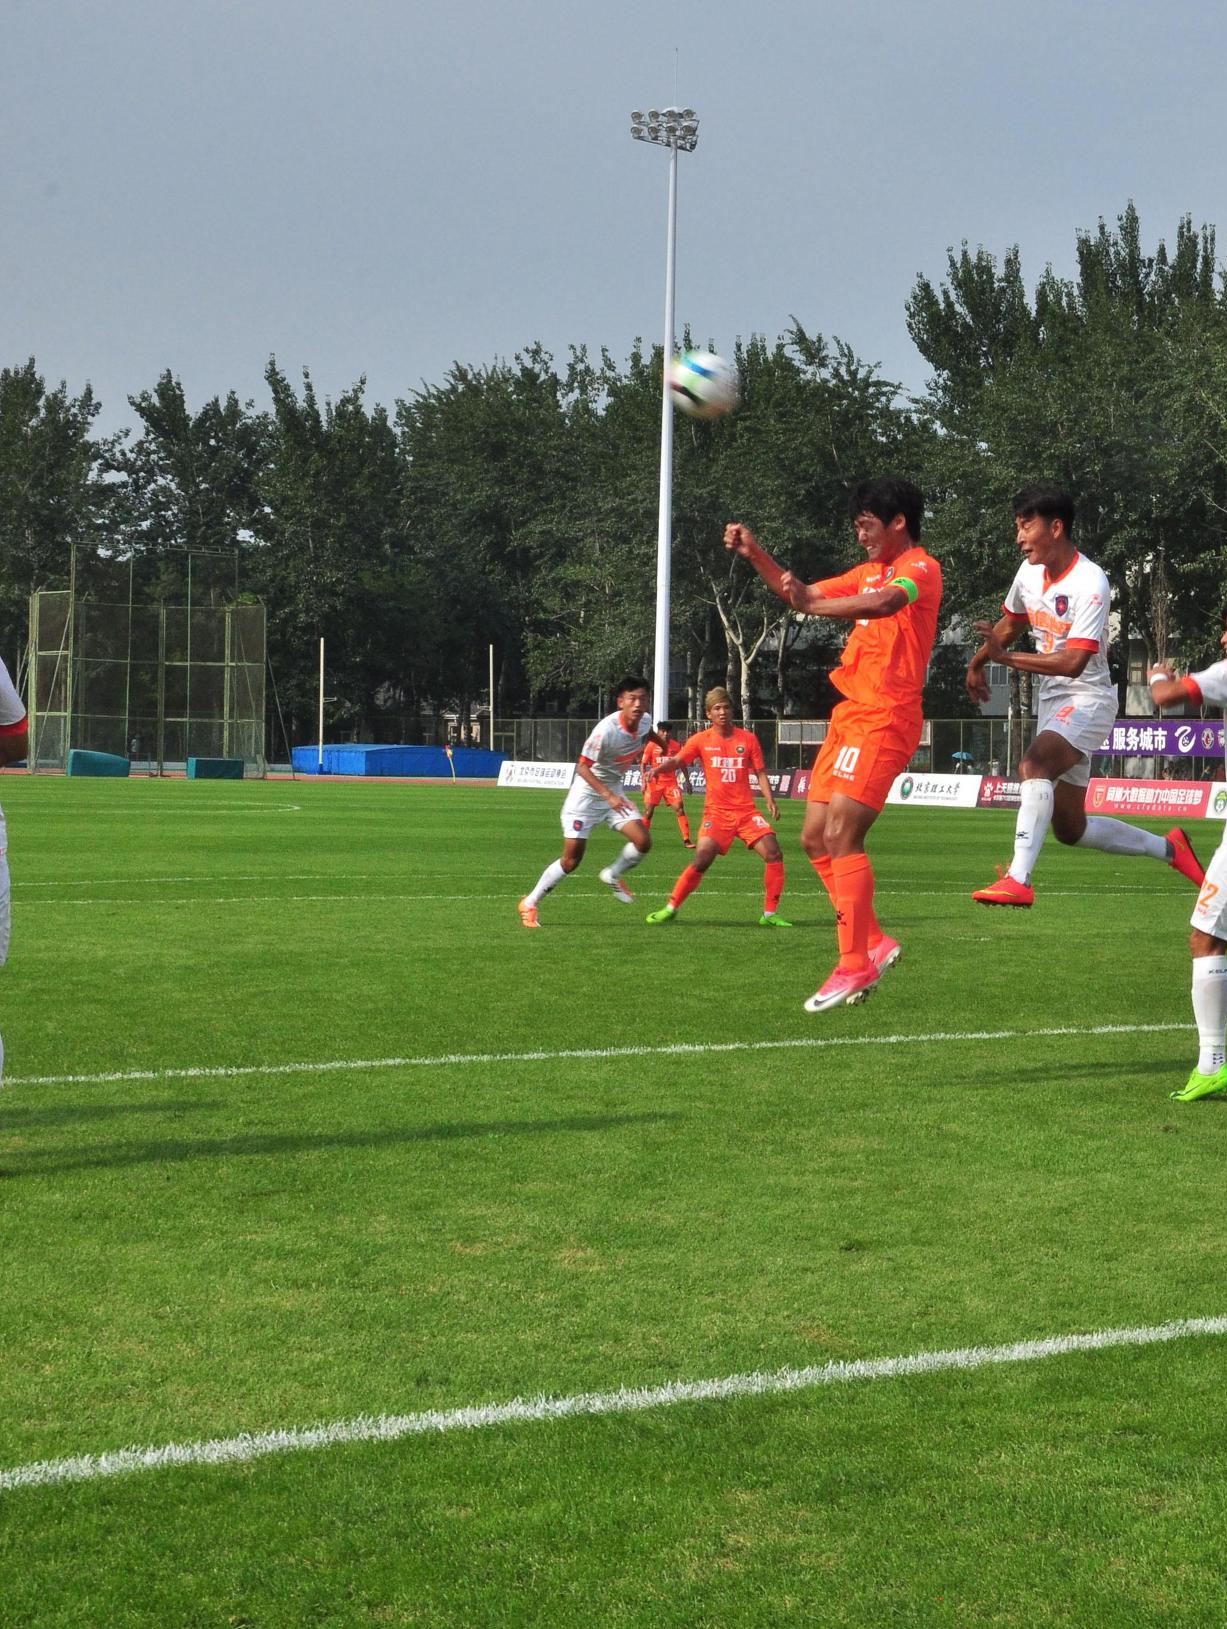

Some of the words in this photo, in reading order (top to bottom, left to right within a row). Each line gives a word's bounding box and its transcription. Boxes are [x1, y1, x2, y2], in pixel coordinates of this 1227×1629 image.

[1113, 727, 1167, 751] 服务城市
[834, 746, 860, 773] 10
[721, 769, 736, 783] 20
